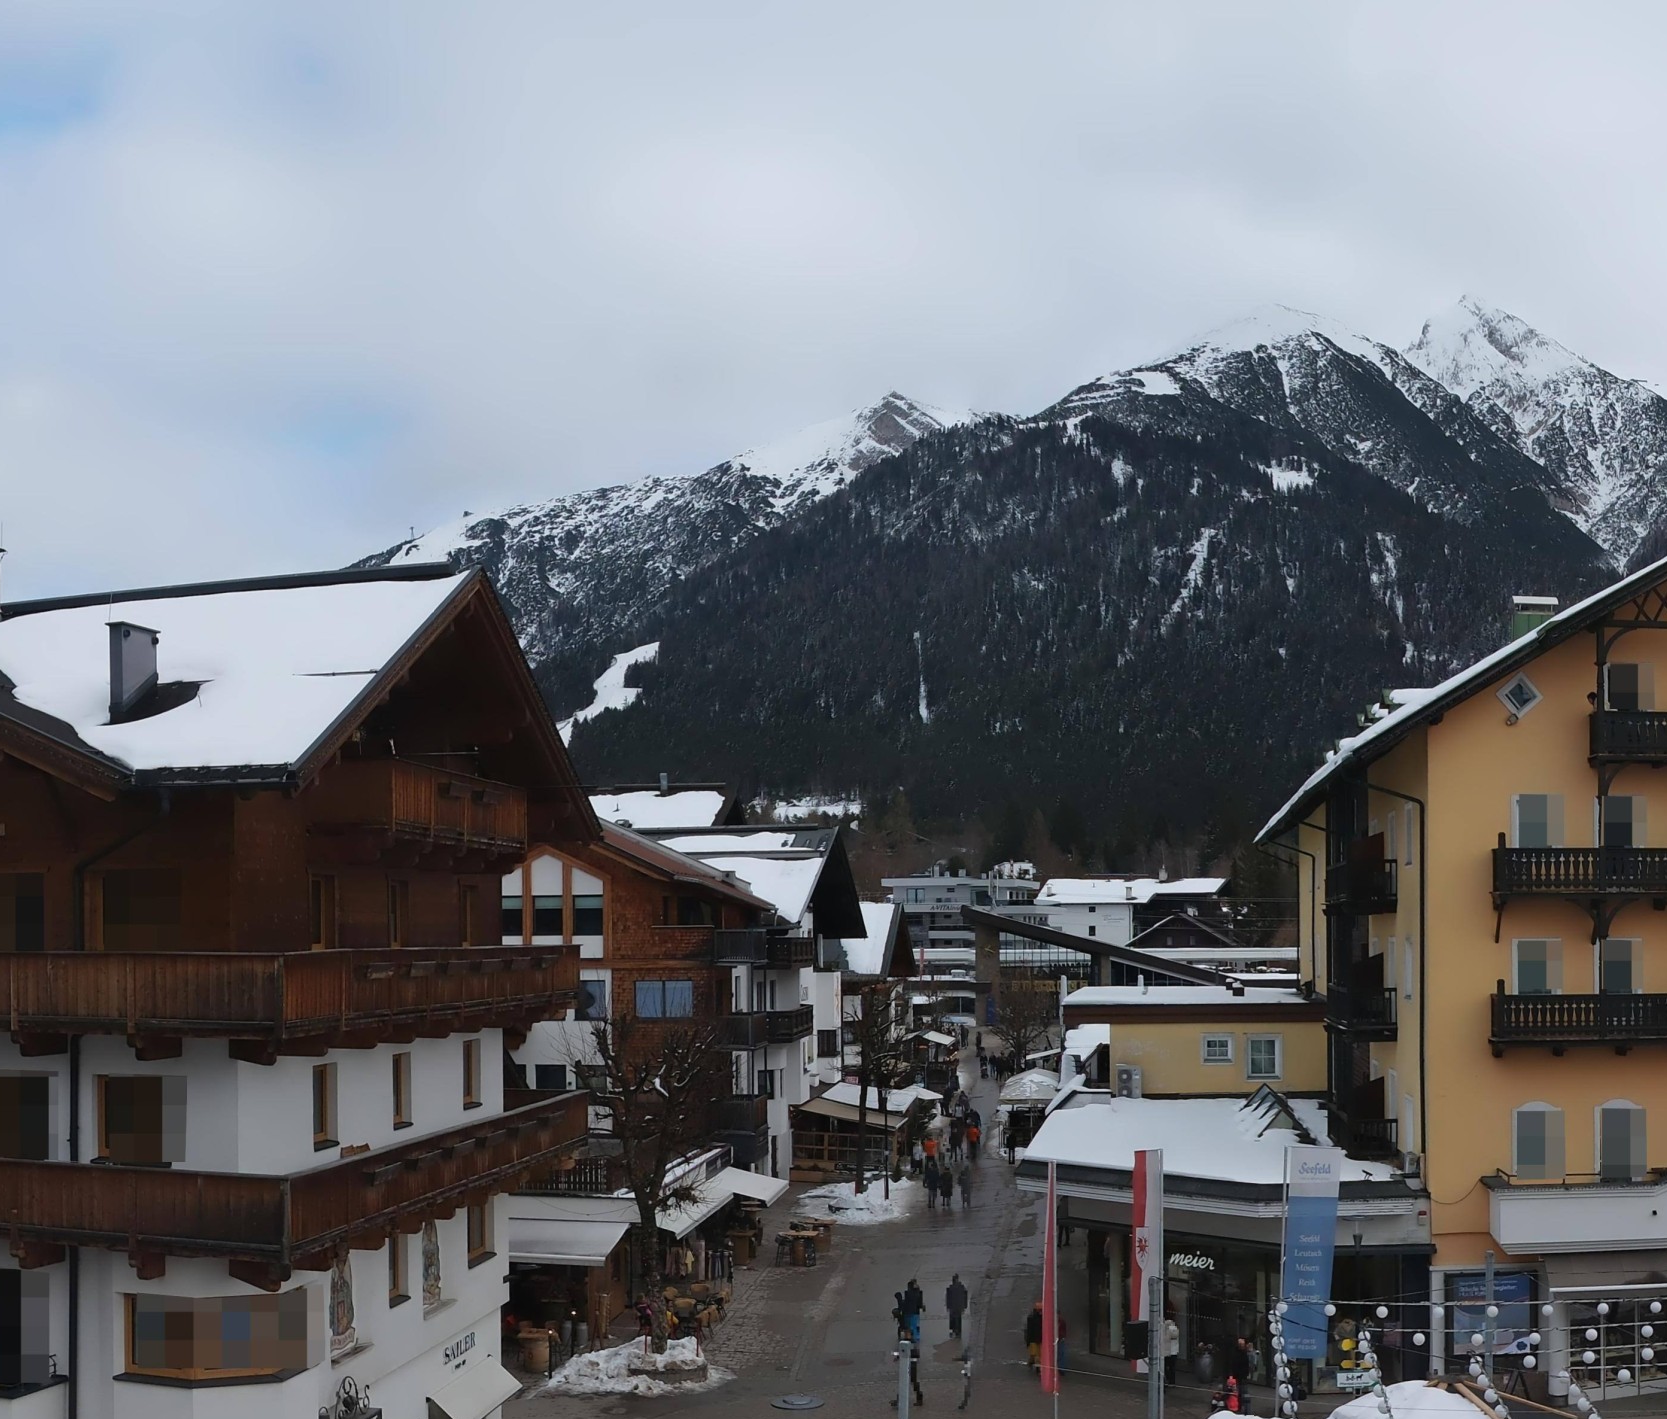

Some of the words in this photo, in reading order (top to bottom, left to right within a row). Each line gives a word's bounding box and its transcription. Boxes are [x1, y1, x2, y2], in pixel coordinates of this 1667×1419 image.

[1298, 1161, 1331, 1176] Seefeld
[1169, 1250, 1215, 1270] meier
[1294, 1248, 1323, 1257] Leutasch
[443, 1331, 476, 1366] SAILER
